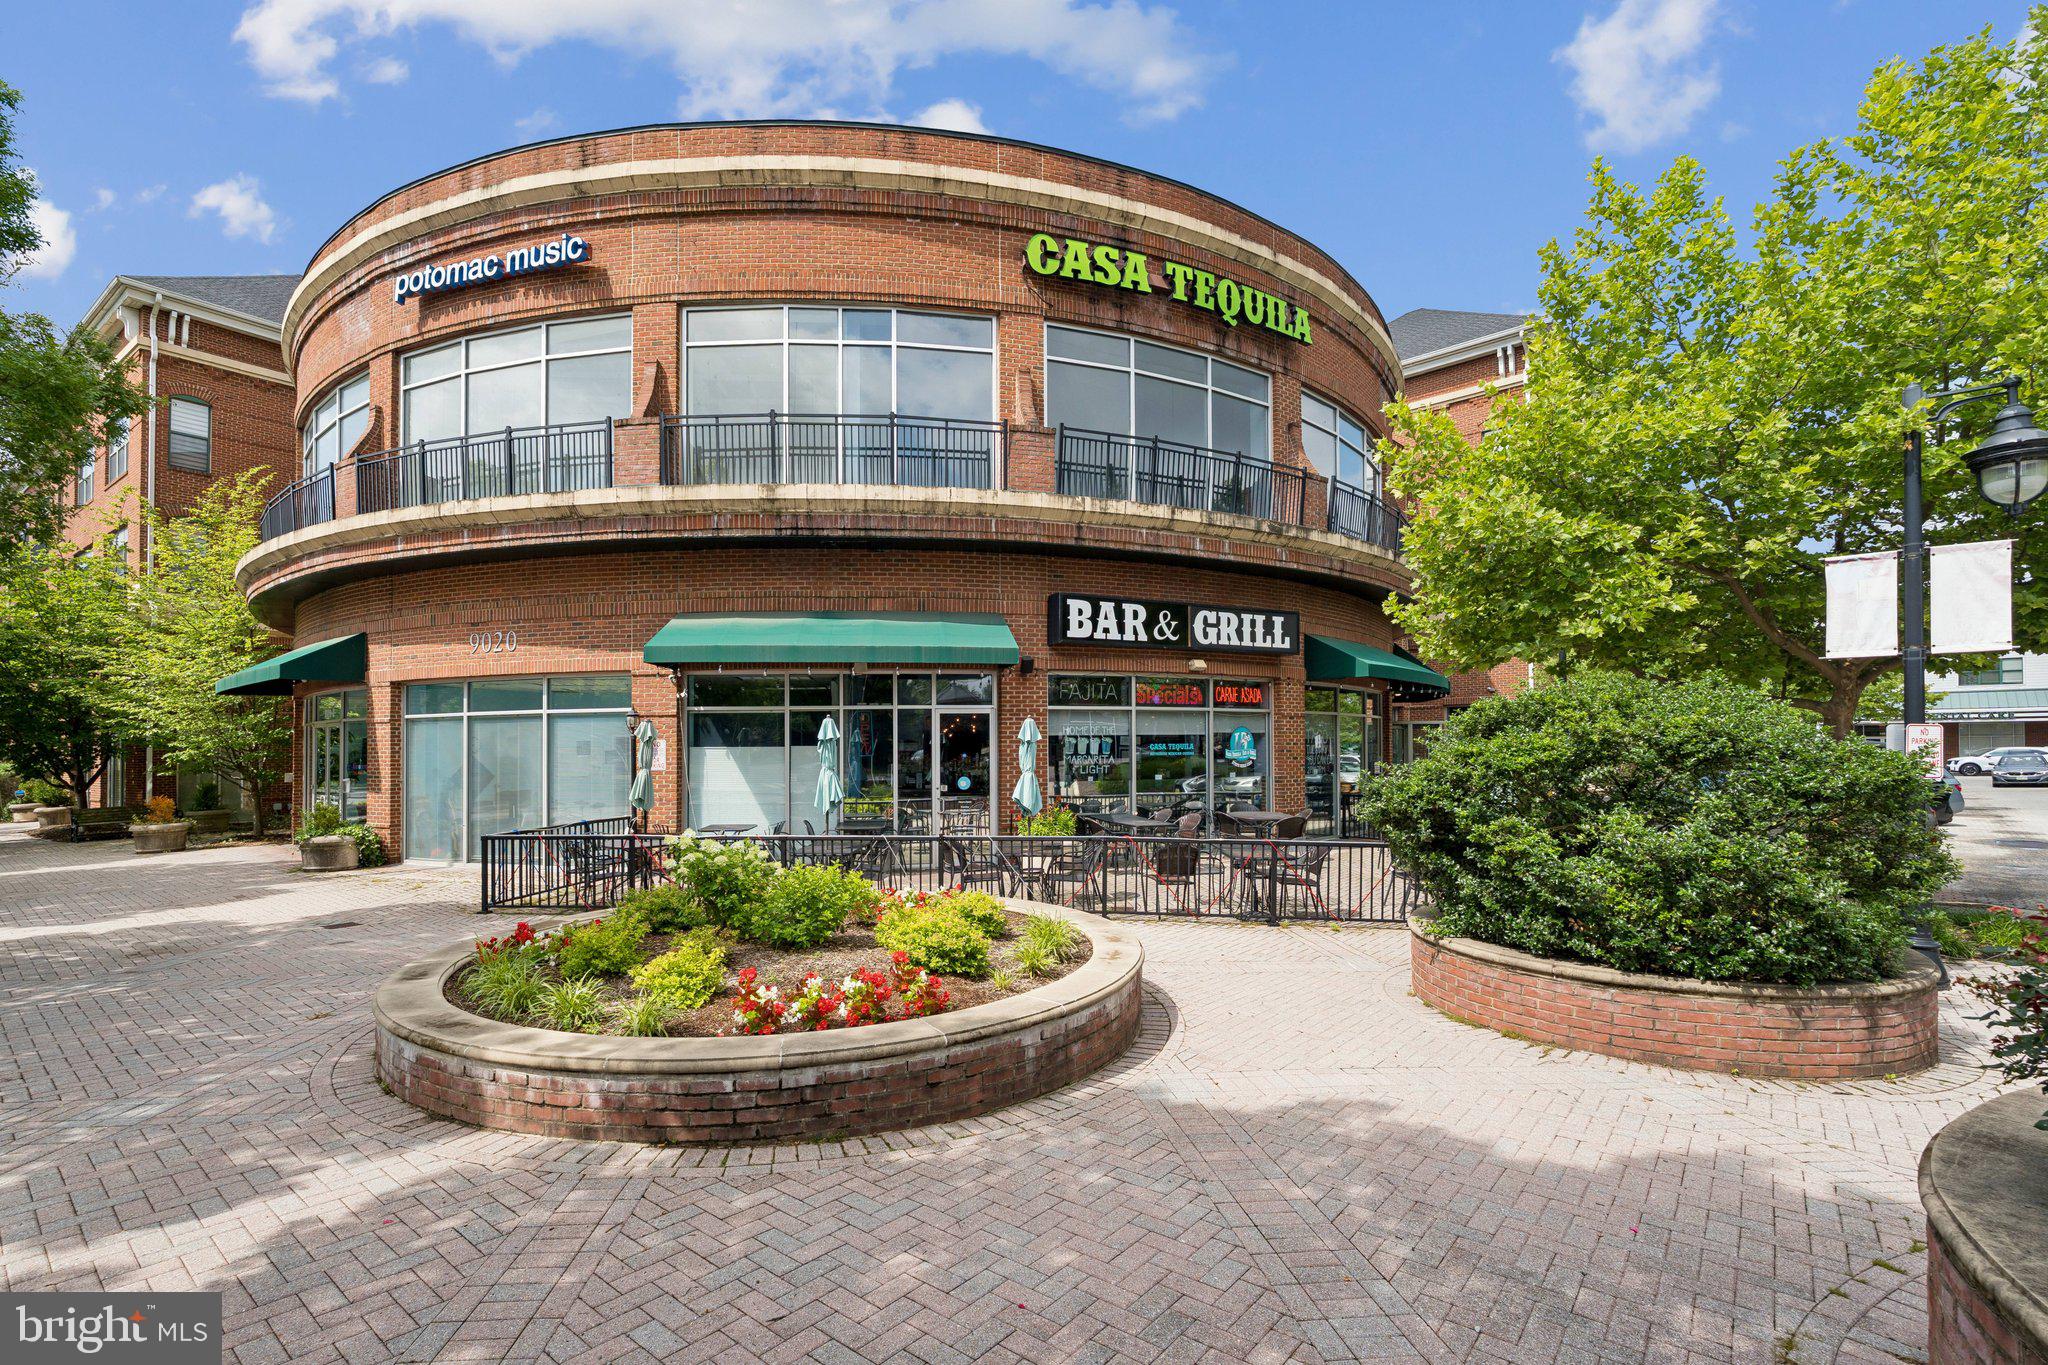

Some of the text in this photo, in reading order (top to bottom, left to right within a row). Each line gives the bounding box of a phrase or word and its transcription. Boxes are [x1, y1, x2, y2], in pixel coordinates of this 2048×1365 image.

[394, 232, 586, 303] potomac music
[1025, 233, 1313, 345] CASA TEQUILA
[1066, 599, 1291, 649] BAR & GRILL
[469, 631, 517, 654] 9020
[1060, 682, 1118, 700] FAJITA
[1215, 686, 1263, 704] CARNE ASADA
[1062, 726, 1089, 735] HOME
[1149, 743, 1194, 751] CASA TEQUILA
[1064, 755, 1115, 765] MARGARITA
